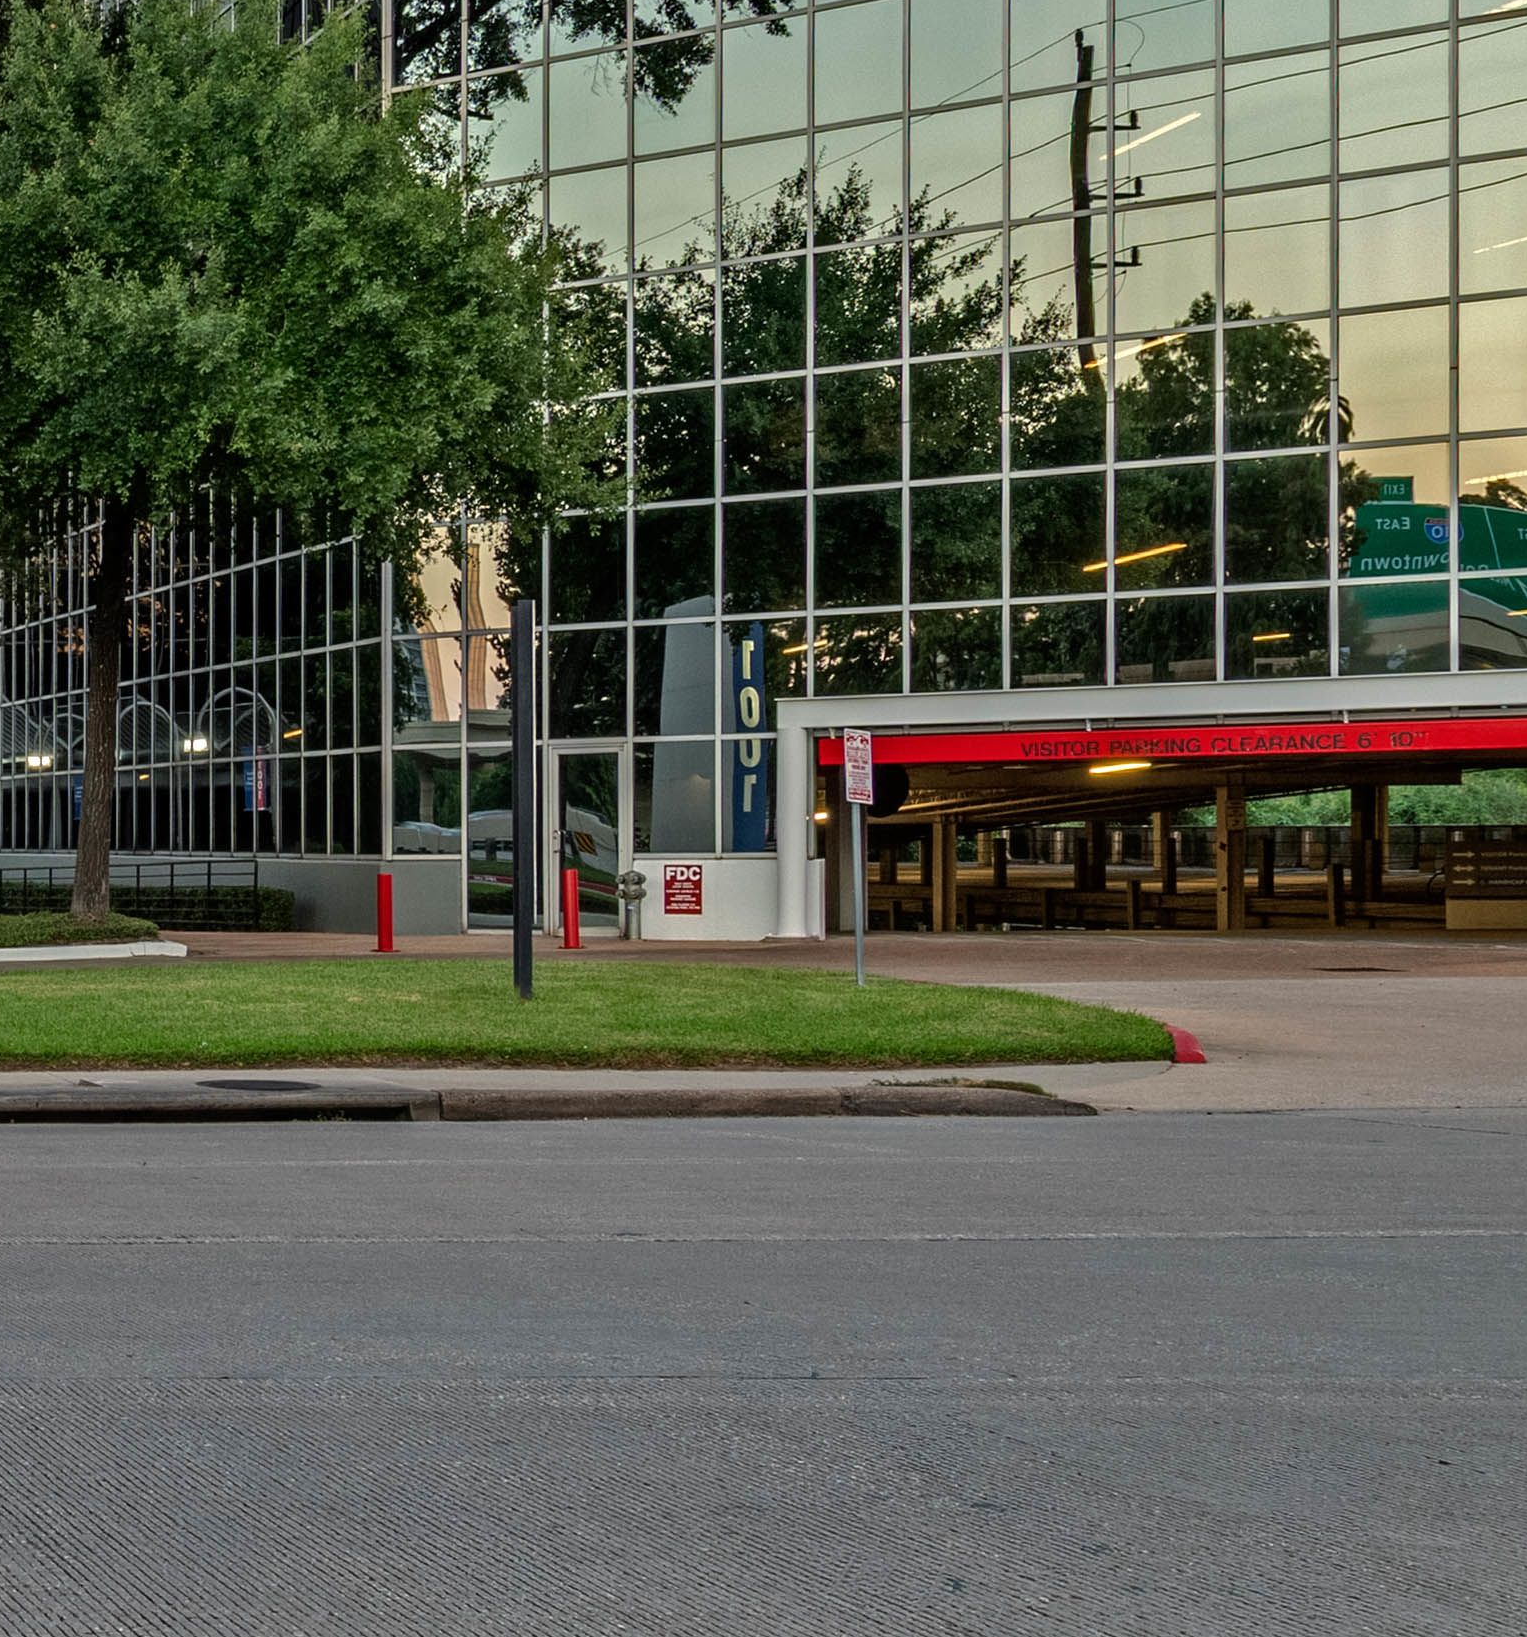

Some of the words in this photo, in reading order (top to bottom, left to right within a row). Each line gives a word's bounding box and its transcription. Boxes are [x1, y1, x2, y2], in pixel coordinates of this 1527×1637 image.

[1021, 741, 1100, 758] VISITOR
[1109, 737, 1202, 756] PARKING
[1211, 733, 1347, 753] CLEARANCE
[665, 866, 701, 881] FDC
